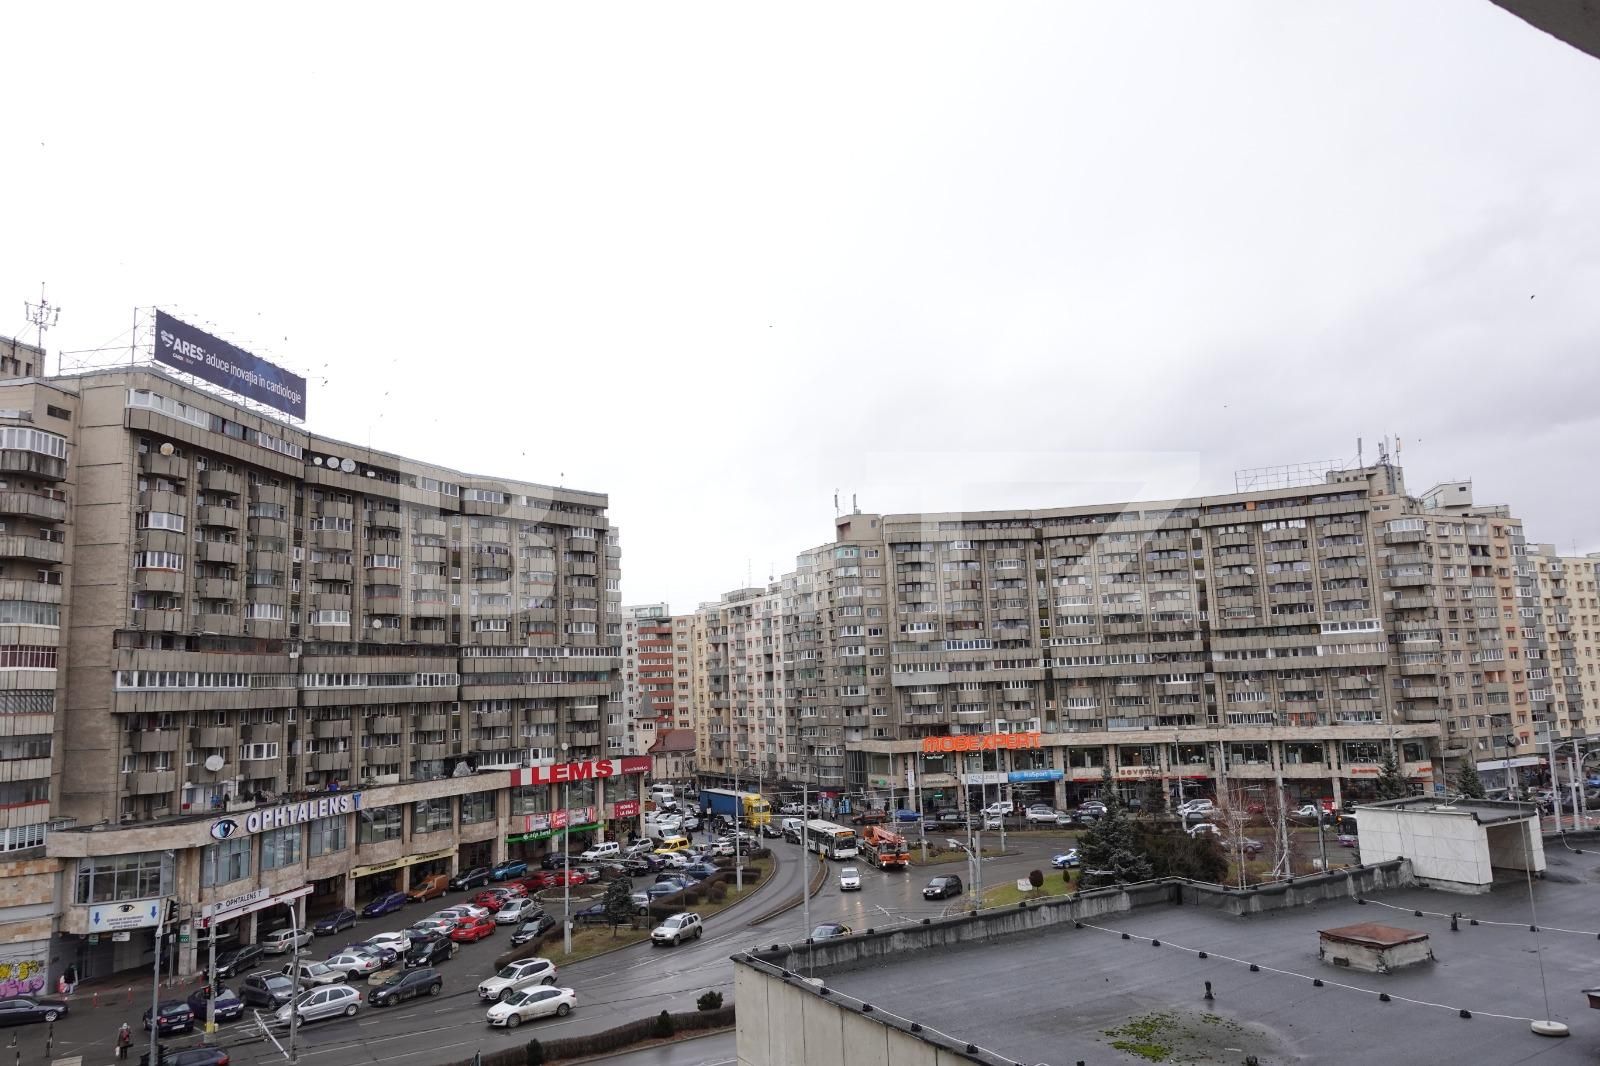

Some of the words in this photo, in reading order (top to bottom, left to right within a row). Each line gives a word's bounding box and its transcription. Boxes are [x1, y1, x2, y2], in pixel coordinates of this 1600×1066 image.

[173, 338, 203, 361] ARES
[206, 353, 230, 373] aduce
[266, 379, 302, 404] cardiologie
[922, 732, 1041, 753] MOBEXPERT
[247, 795, 349, 833] OPHTALENS
[352, 791, 362, 810] T
[225, 891, 257, 907] OPHTALENS
